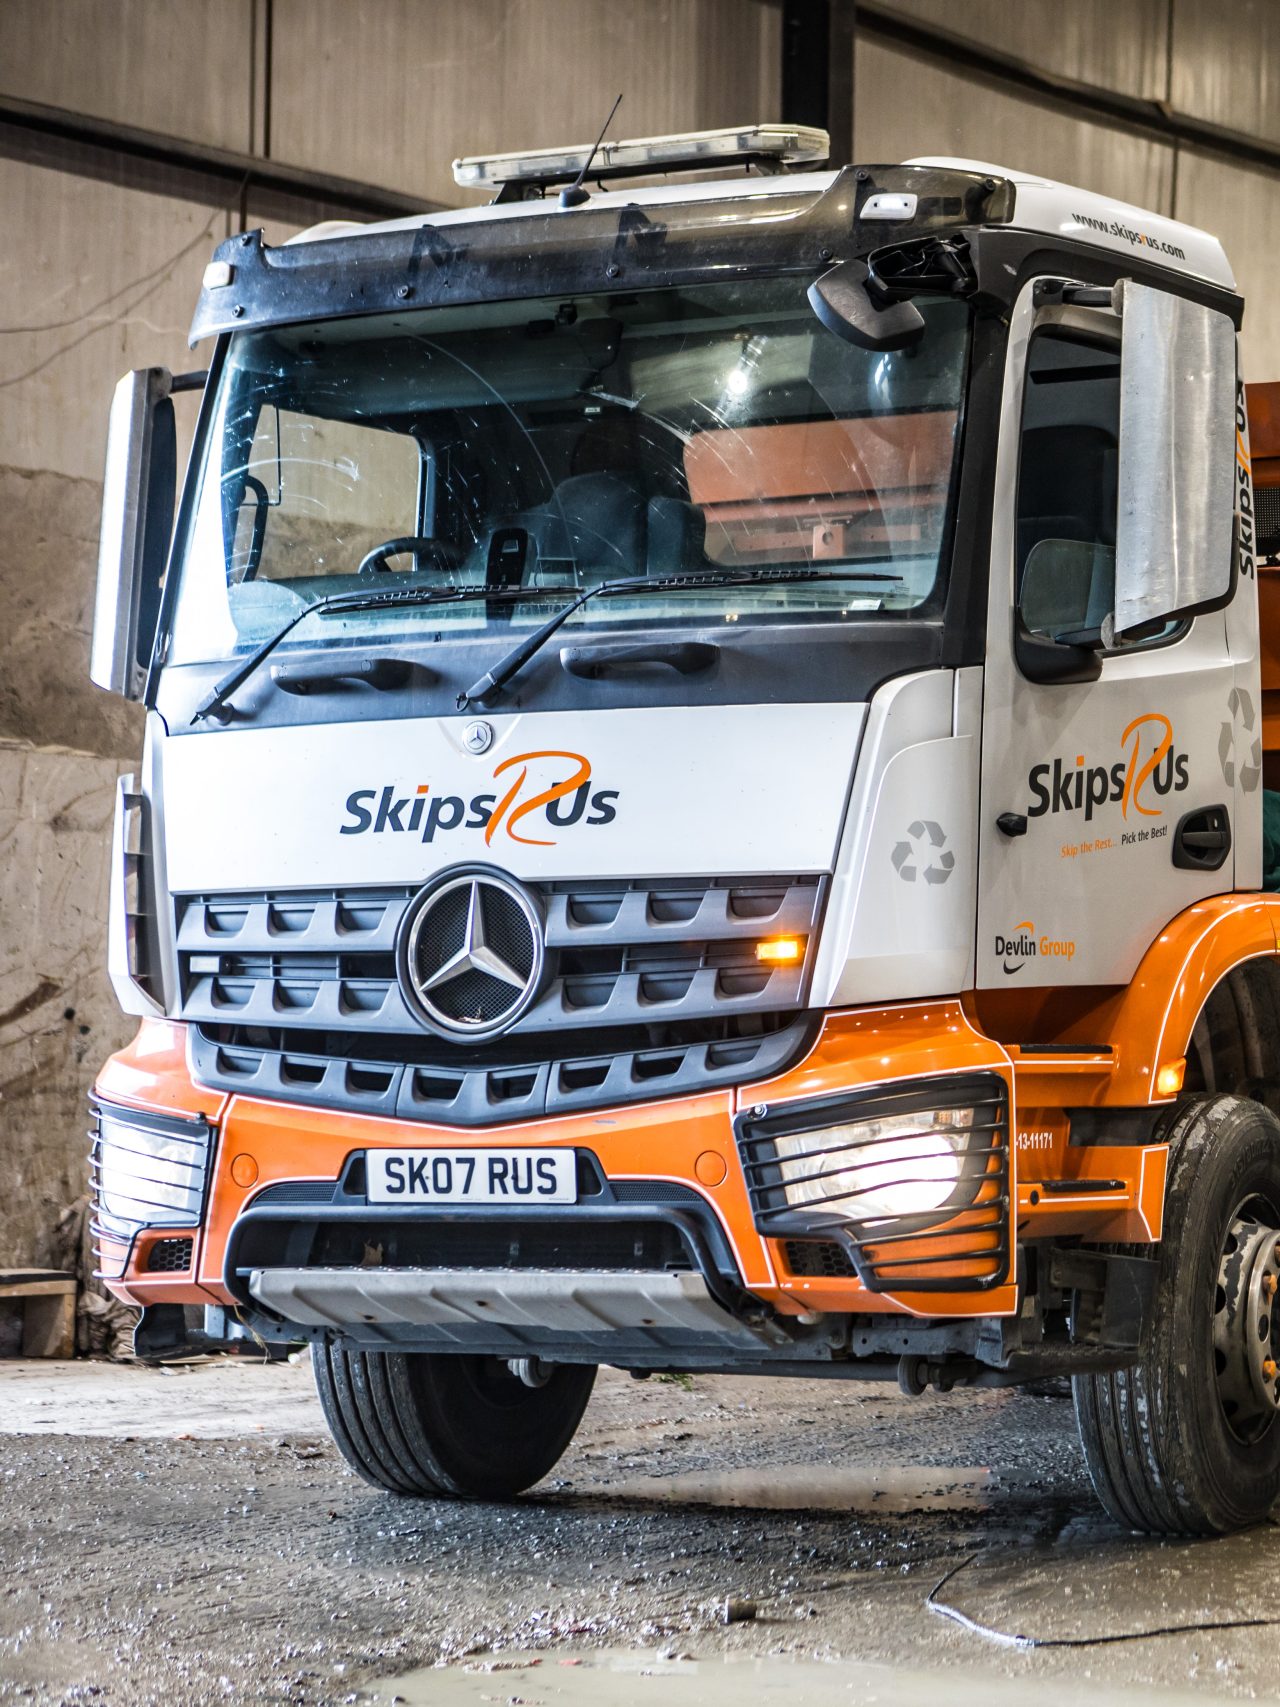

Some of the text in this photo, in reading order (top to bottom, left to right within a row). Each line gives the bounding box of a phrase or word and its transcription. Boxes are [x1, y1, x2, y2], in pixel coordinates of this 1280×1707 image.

[1071, 213, 1185, 260] www.skipsrus.com
[1061, 843, 1078, 859] Skip
[1080, 841, 1093, 853] the
[1121, 832, 1136, 846] Pick
[1138, 829, 1149, 841] the
[1151, 825, 1168, 838] Best!
[995, 935, 1075, 961] Devlin Group
[385, 1157, 557, 1195] SK07 RUS
